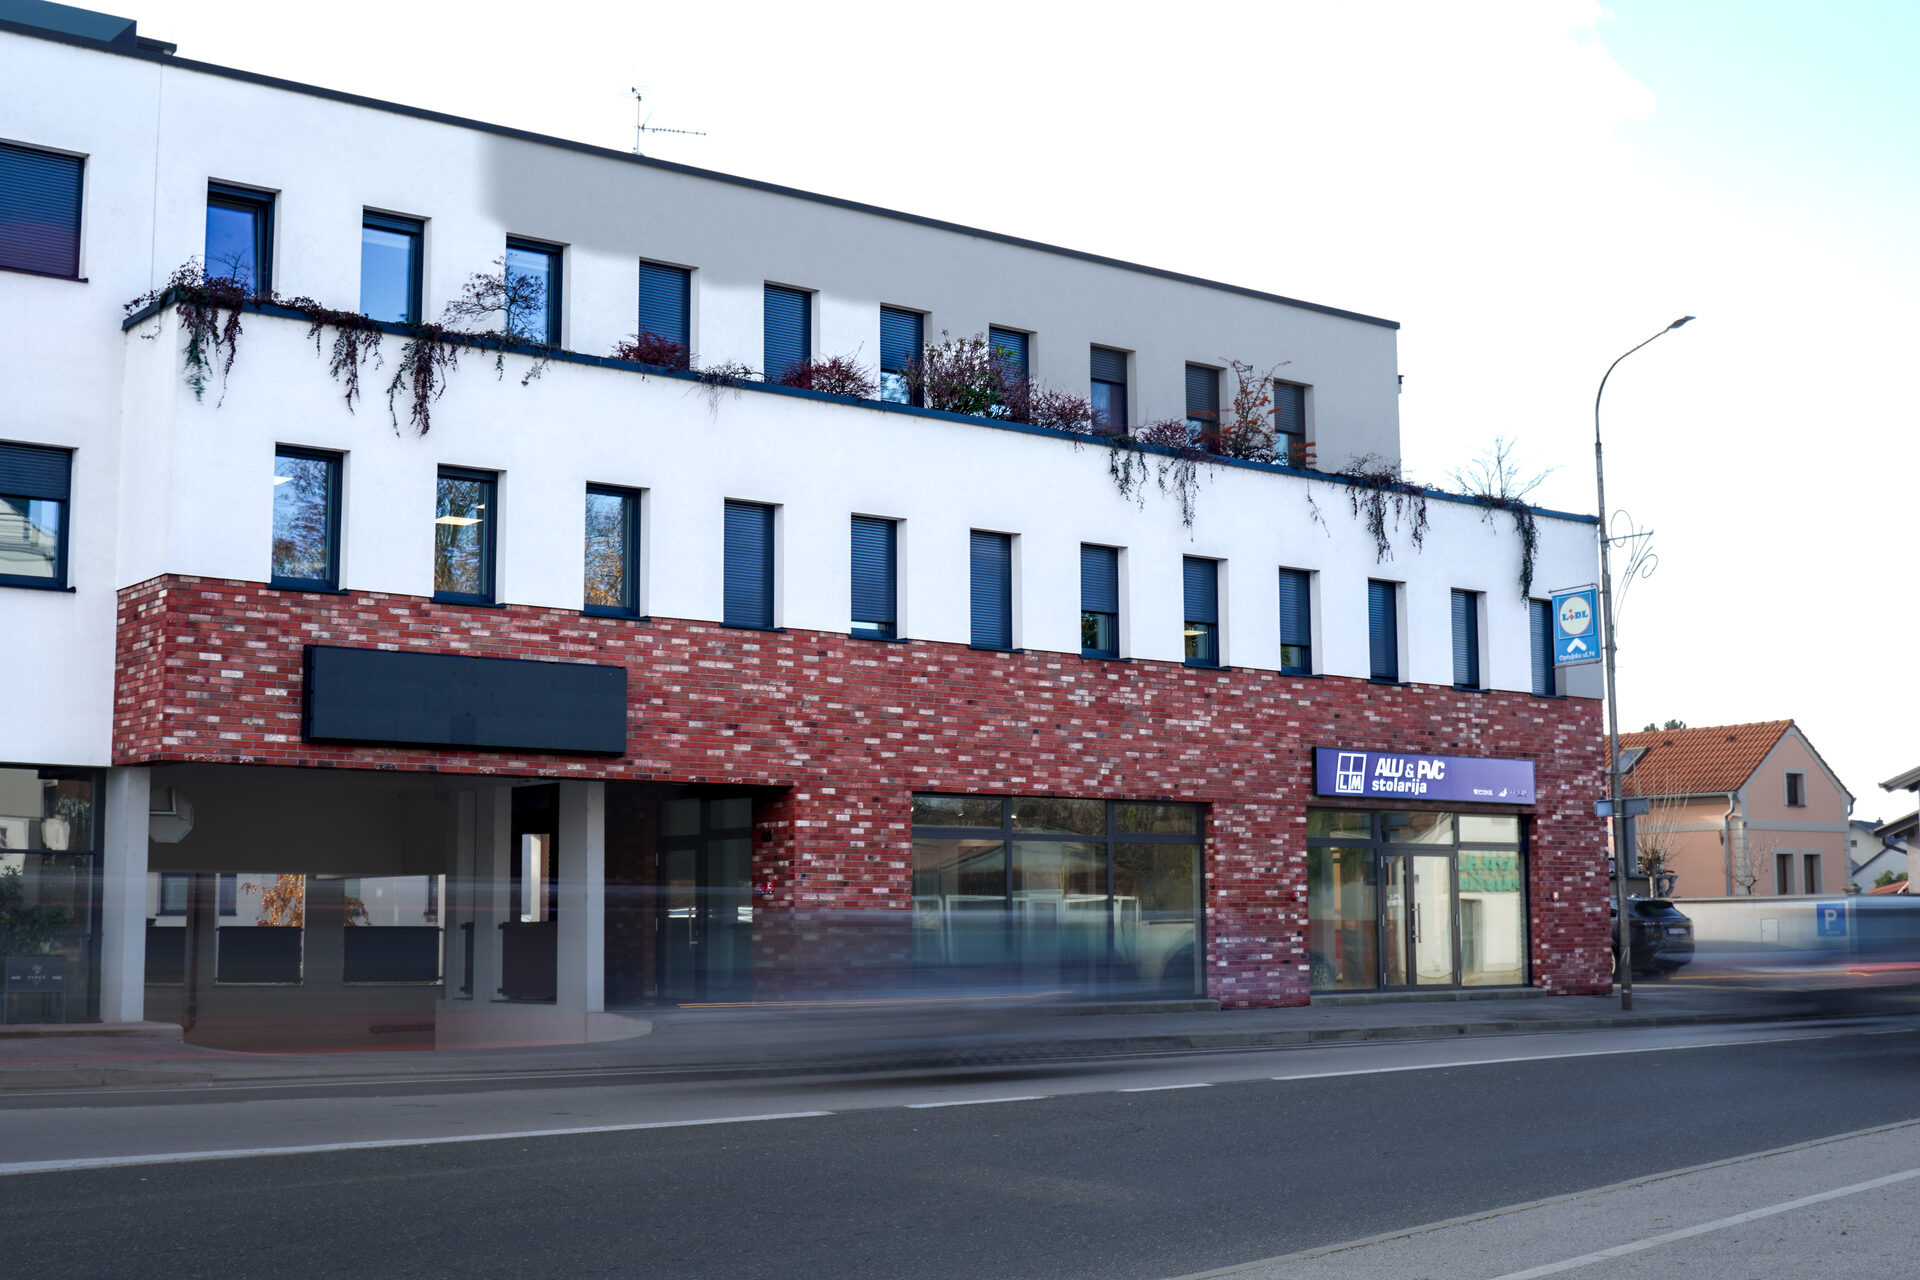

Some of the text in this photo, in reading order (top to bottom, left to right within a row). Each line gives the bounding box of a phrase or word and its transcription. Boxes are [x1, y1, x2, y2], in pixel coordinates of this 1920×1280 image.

[1375, 758, 1445, 780] ALU & PVC
[1371, 778, 1427, 795] stolarija
[1825, 909, 1837, 930] P
